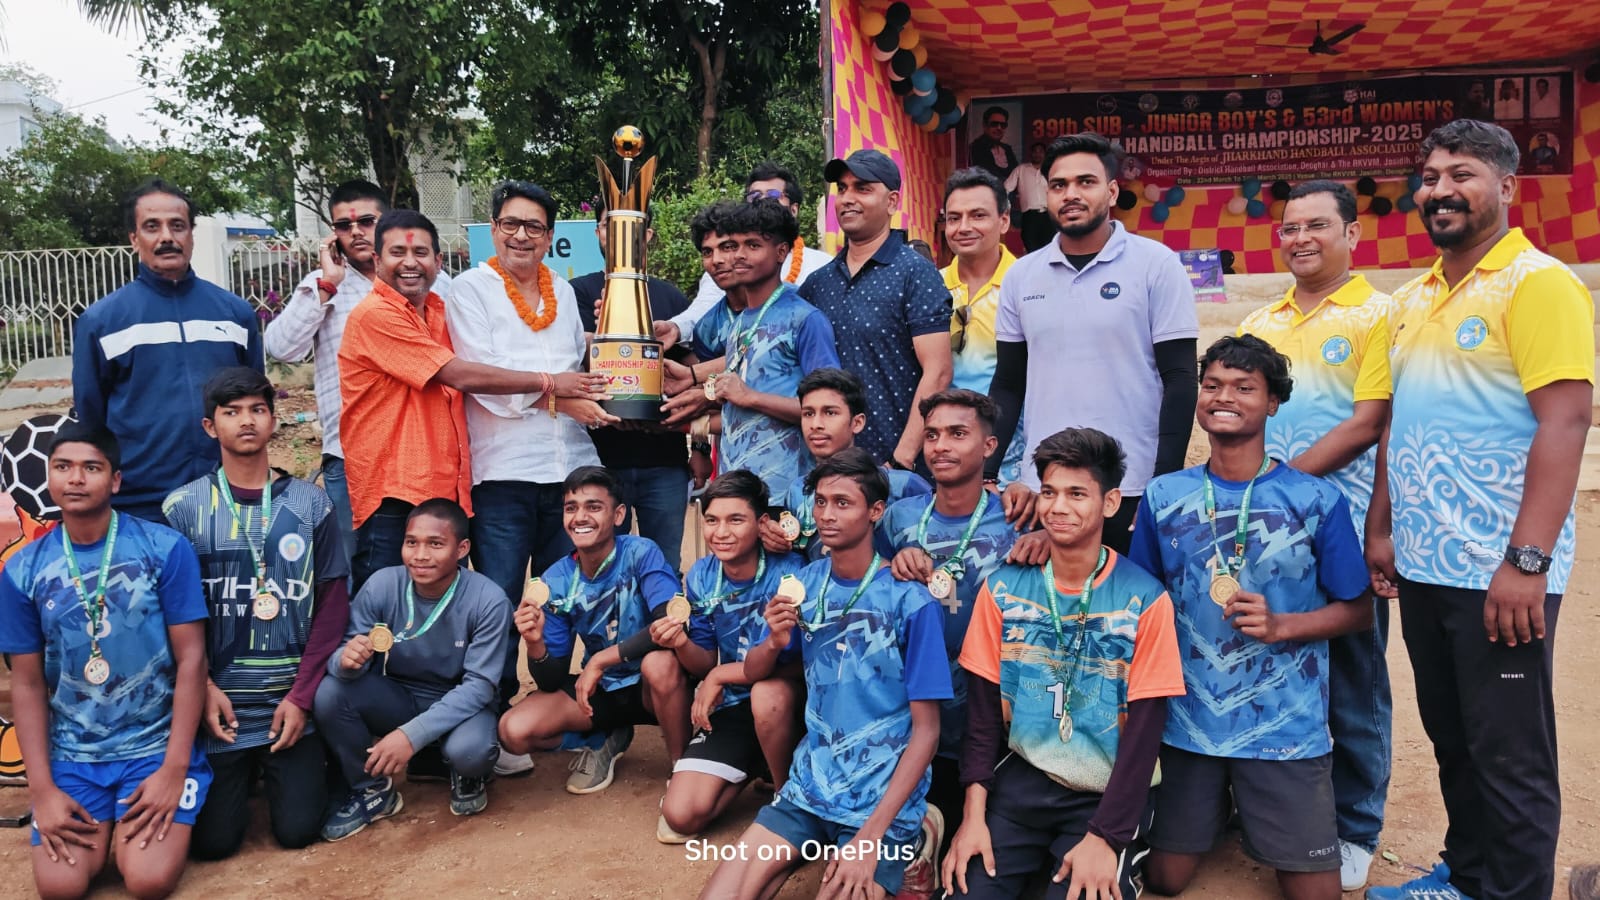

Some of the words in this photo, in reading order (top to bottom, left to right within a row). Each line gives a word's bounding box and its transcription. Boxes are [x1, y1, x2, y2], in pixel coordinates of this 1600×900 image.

[1032, 117, 1078, 138] 39th
[1083, 115, 1122, 135] SUB
[1141, 111, 1212, 133] JUNIOR
[1218, 109, 1278, 131] BOY'S
[1282, 108, 1296, 127] &
[1303, 105, 1354, 127] 53rd
[1360, 100, 1454, 123] WOMEN'S
[1125, 134, 1217, 154] HANDBALL
[1151, 156, 1174, 165] Under
[1176, 155, 1189, 164] The
[1219, 149, 1288, 165] JHARKHAND
[1291, 146, 1345, 159] HANDBALL
[1350, 142, 1420, 156] ASSOCIATION
[1147, 166, 1182, 177] Organised
[1184, 166, 1192, 177] By
[1198, 165, 1223, 175] District
[1225, 164, 1256, 174] Handball
[1301, 160, 1328, 171] Deoghar
[1339, 159, 1351, 168] The
[1023, 294, 1045, 302] COACH
[201, 576, 310, 601] TIHAD
[179, 777, 199, 810] 8
